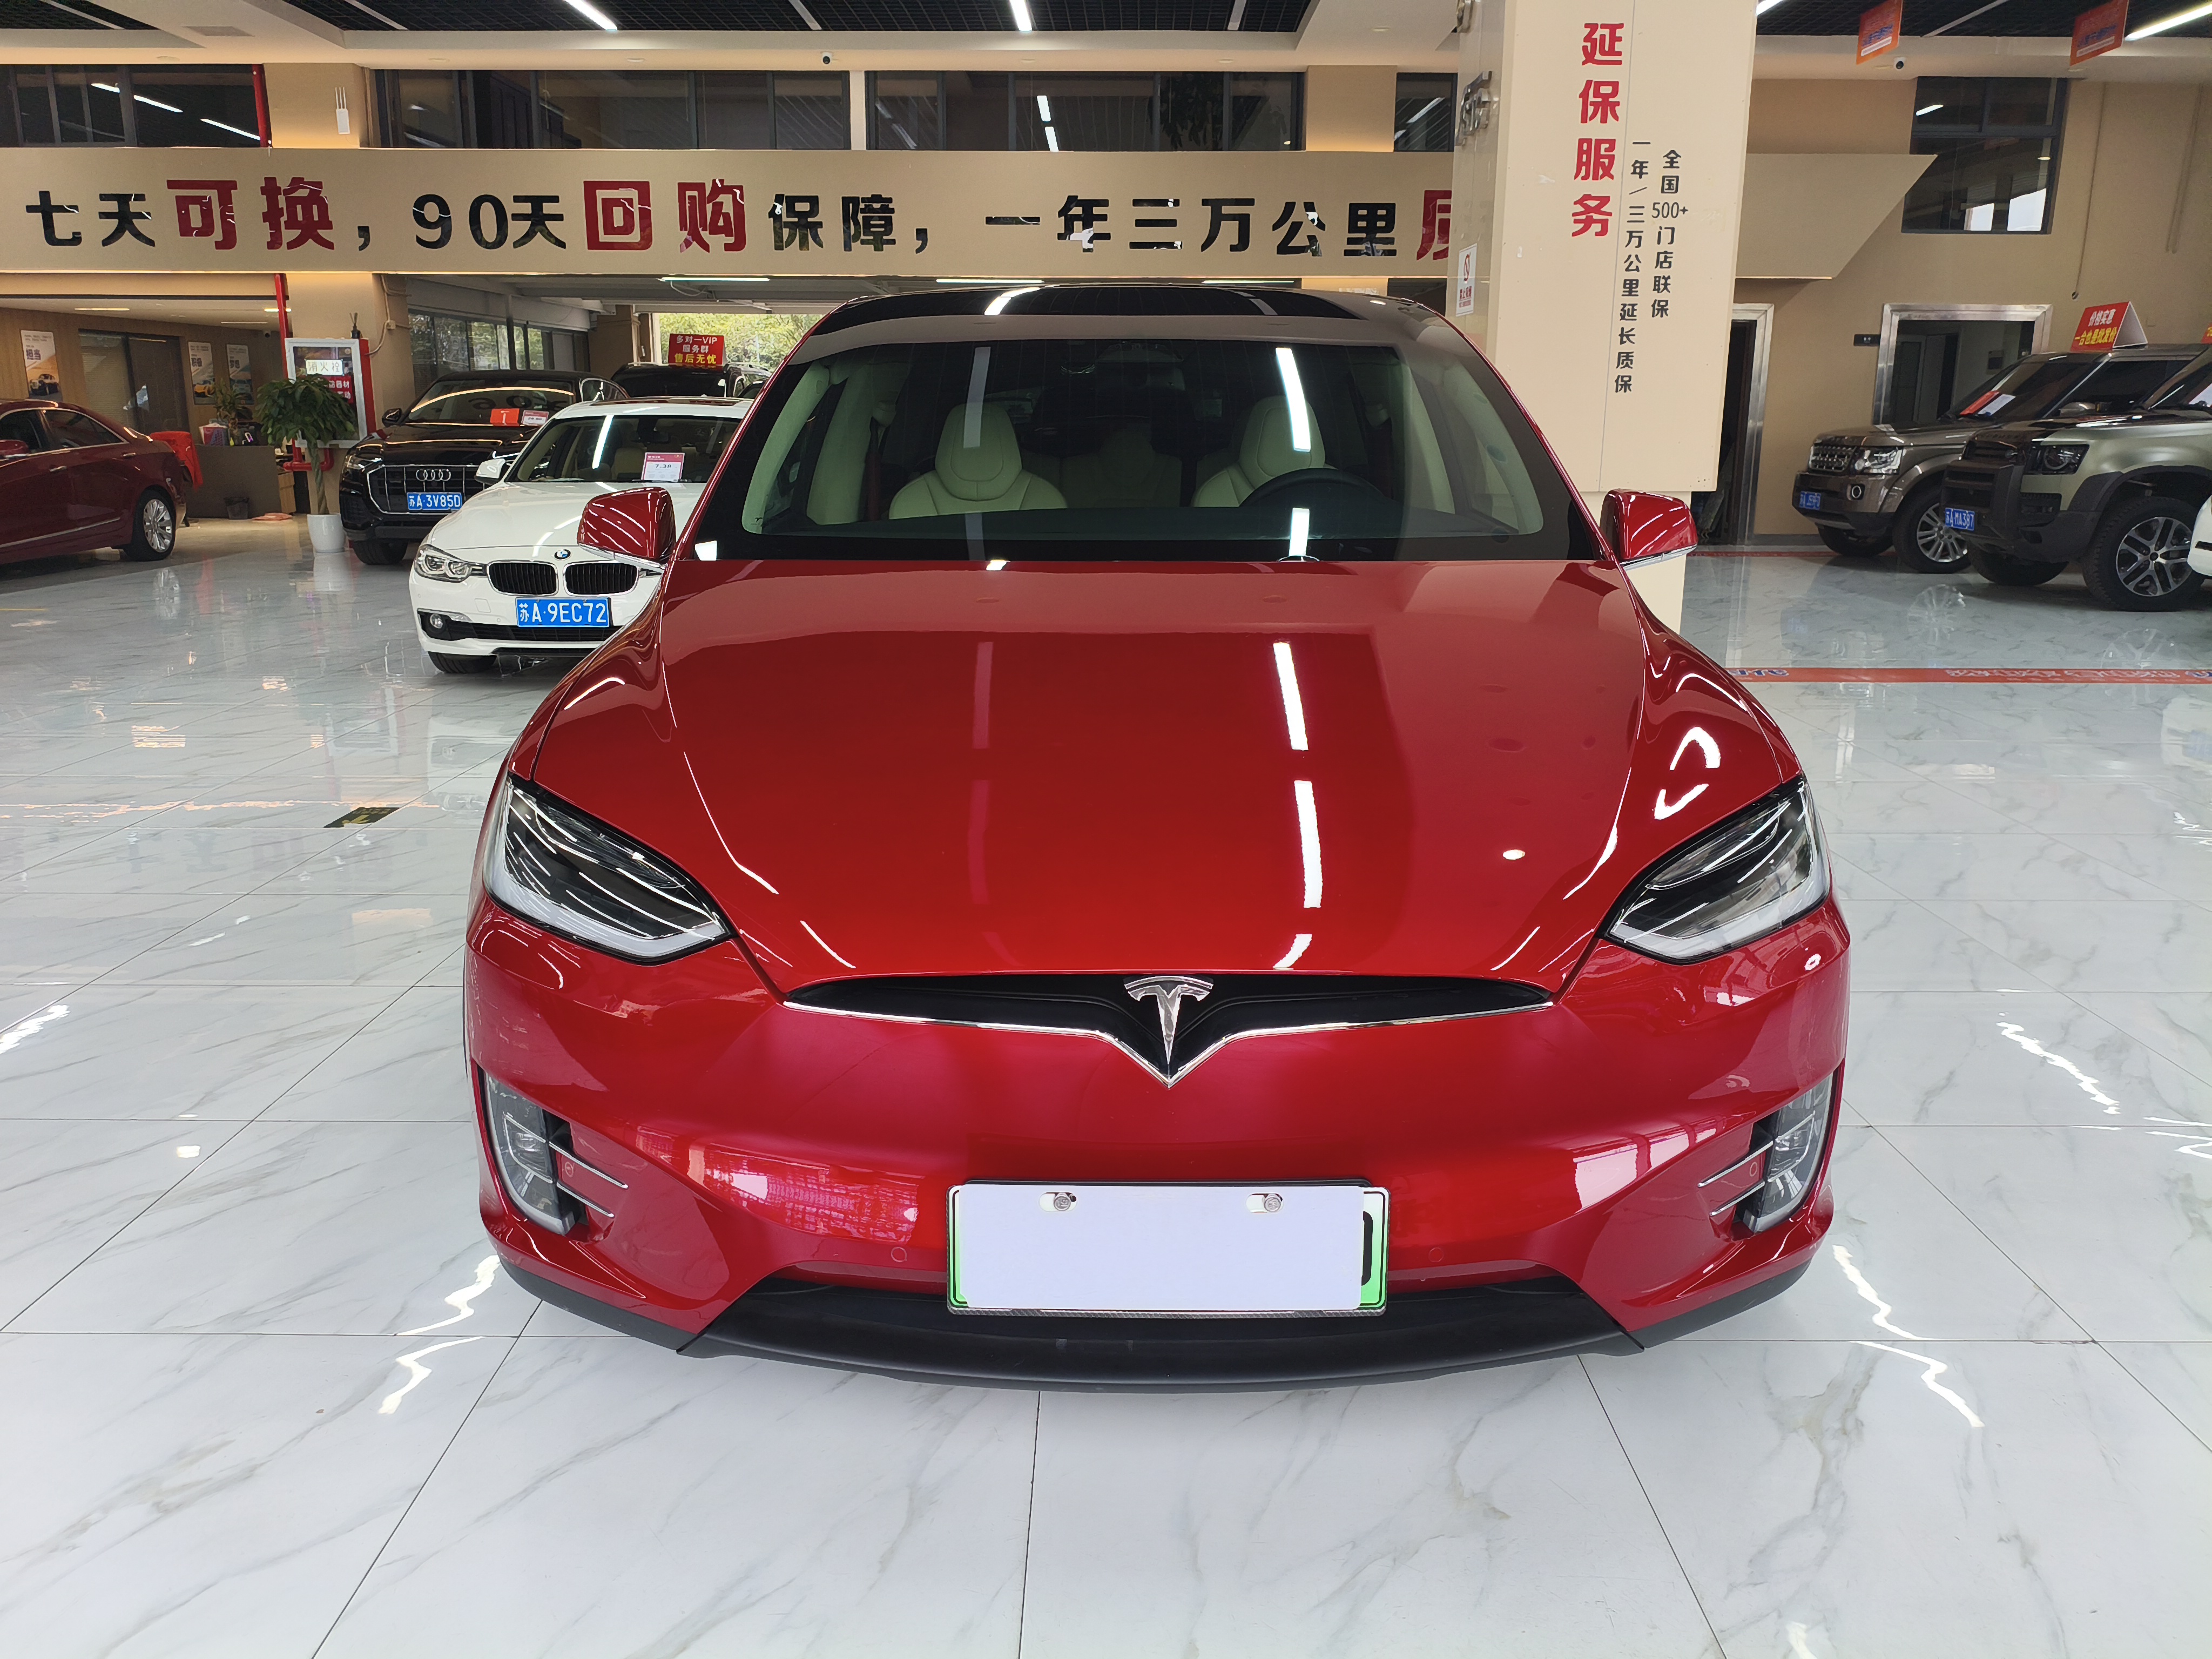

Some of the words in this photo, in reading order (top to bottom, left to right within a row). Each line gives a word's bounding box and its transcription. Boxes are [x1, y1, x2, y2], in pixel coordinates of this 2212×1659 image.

[1572, 23, 1624, 237] 延保服务
[1651, 150, 1689, 319] 全国500+门店联保
[2088, 309, 2116, 327] 价格实惠
[676, 335, 718, 345] 多对一VIP
[683, 344, 709, 353] 服务群
[675, 353, 717, 364] 售后无忧
[307, 361, 340, 372] 消火栓
[518, 602, 606, 623] 苏A·9EC72
